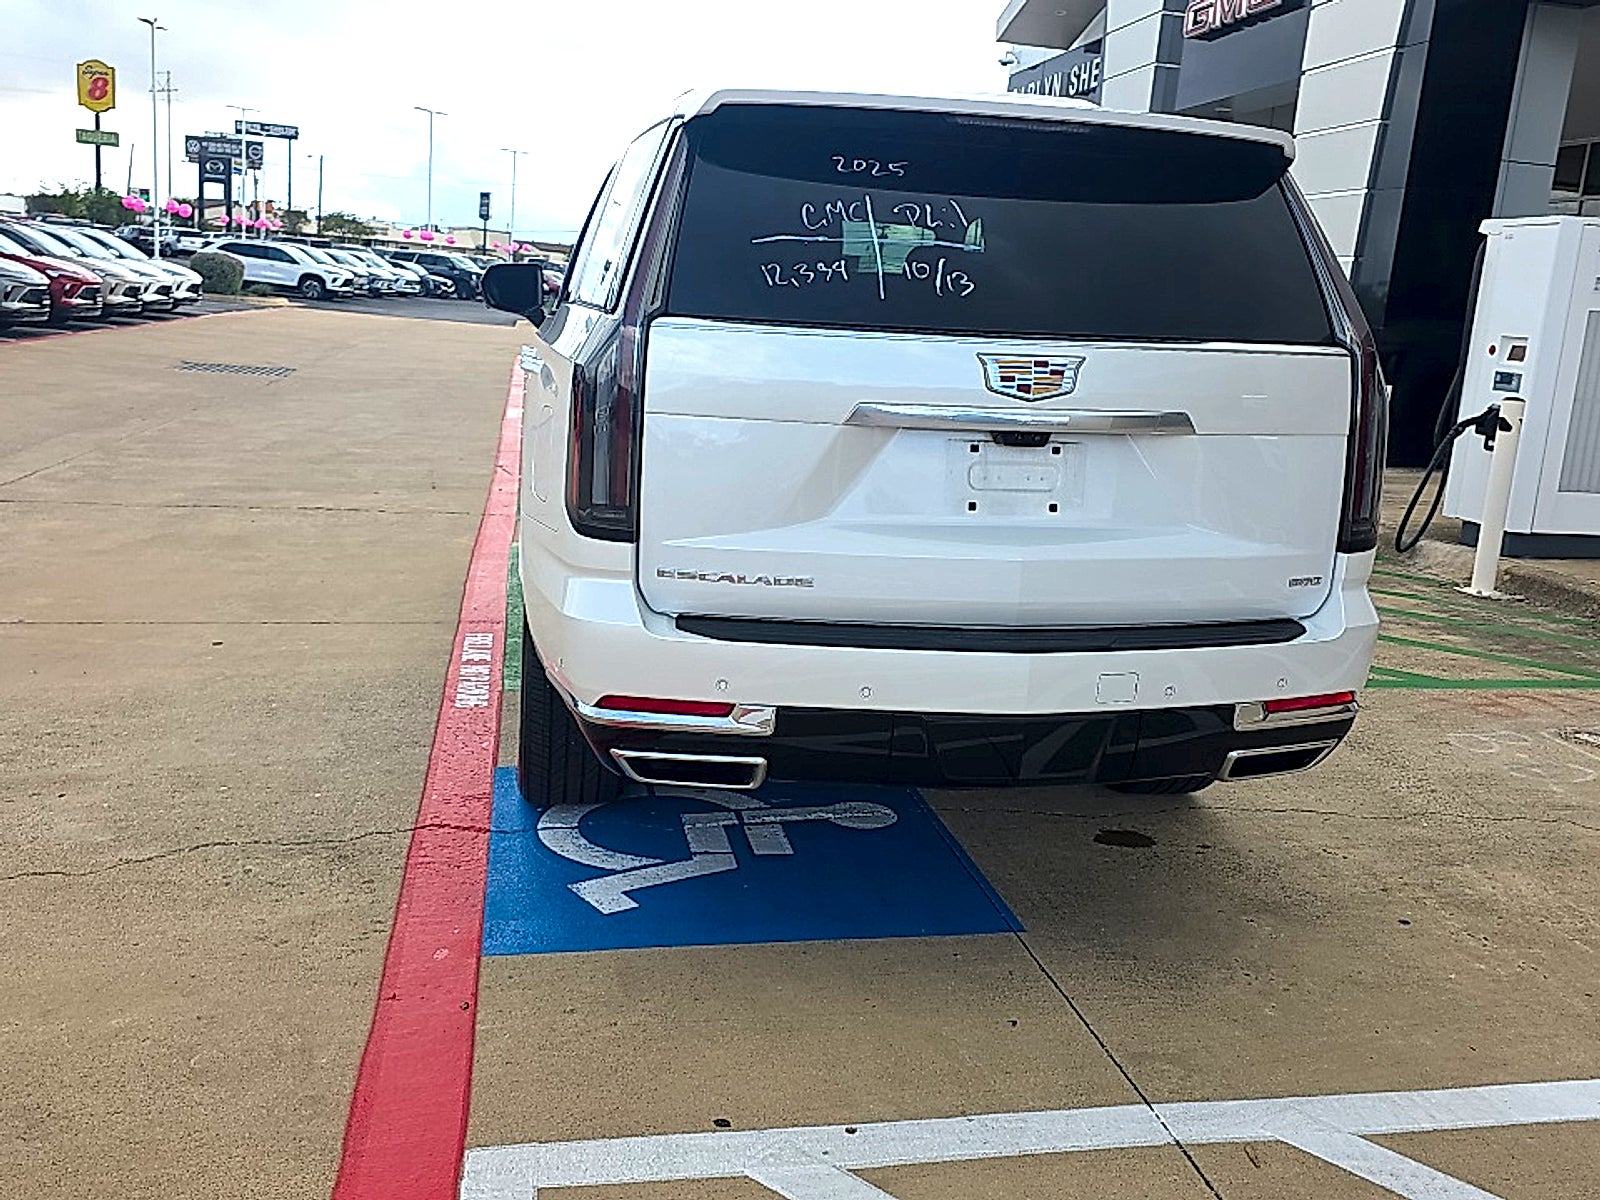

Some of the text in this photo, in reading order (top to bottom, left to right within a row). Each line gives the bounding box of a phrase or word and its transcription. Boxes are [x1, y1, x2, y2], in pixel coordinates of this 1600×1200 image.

[87, 77, 109, 101] 8
[832, 156, 908, 176] 2025
[802, 200, 863, 230] GMC
[904, 258, 975, 297] 10/13
[656, 568, 815, 588] ESCALADE
